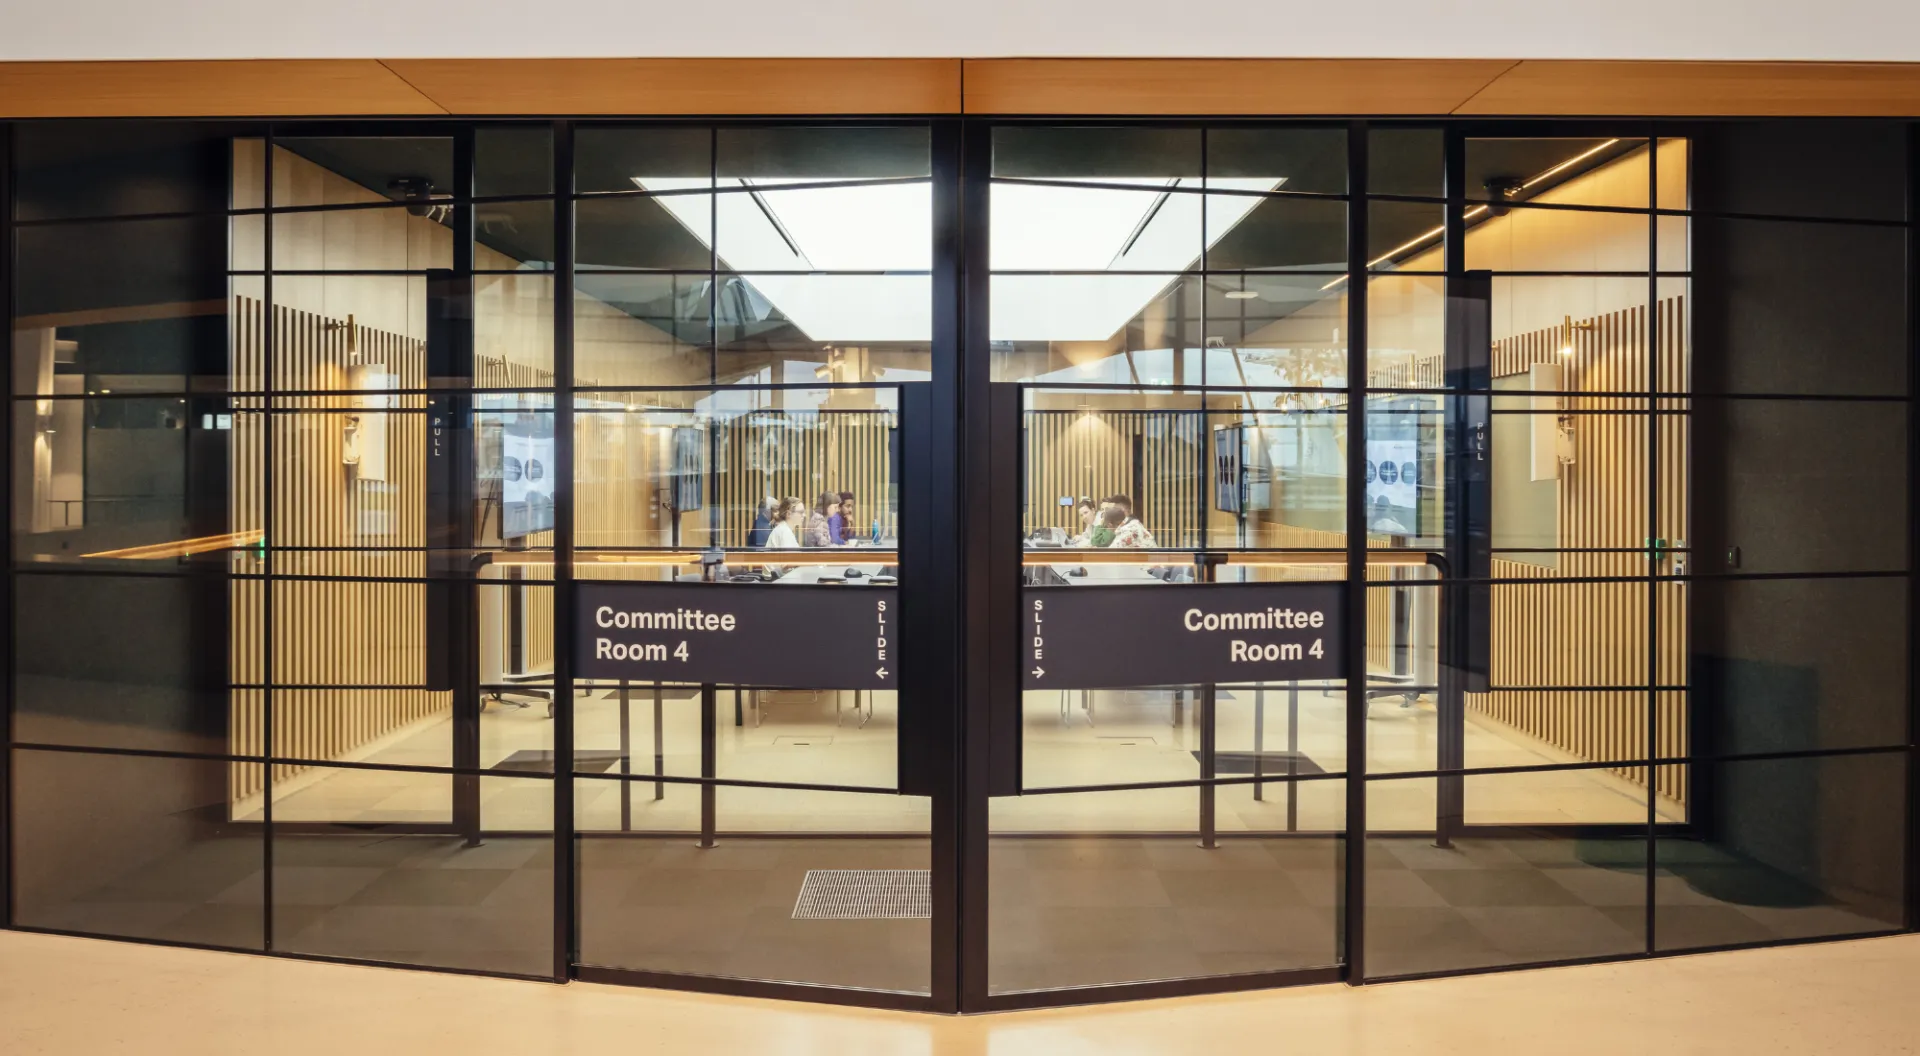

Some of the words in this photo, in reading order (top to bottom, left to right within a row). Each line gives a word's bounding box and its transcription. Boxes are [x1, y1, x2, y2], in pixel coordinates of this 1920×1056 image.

[596, 606, 736, 632] Committee
[878, 600, 887, 661] SLIDE
[1034, 599, 1043, 660] SLIDE
[1184, 607, 1325, 632] Committee
[597, 638, 667, 662] Room
[673, 640, 689, 662] 4
[1231, 639, 1303, 663] Room
[1308, 638, 1324, 660] 4
